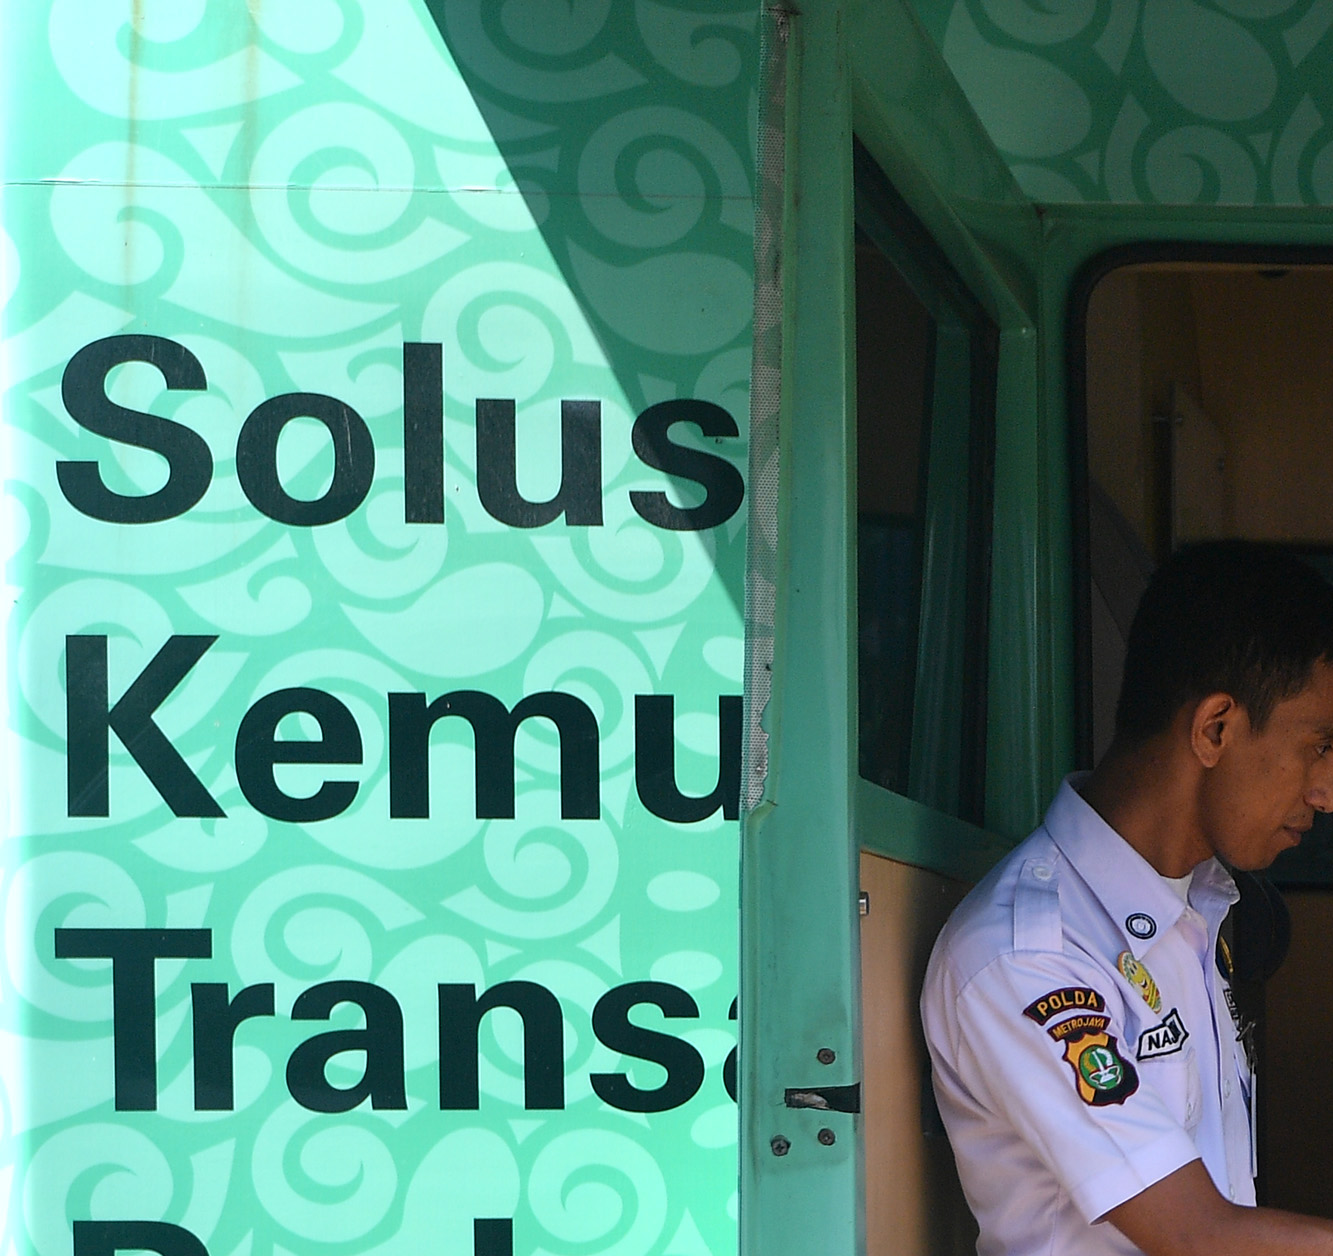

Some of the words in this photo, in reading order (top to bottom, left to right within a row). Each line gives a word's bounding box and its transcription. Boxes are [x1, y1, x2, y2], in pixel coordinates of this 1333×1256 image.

[65, 634, 744, 823] Kemu
[54, 927, 738, 1114] Trans
[1037, 989, 1099, 1017] POLDA
